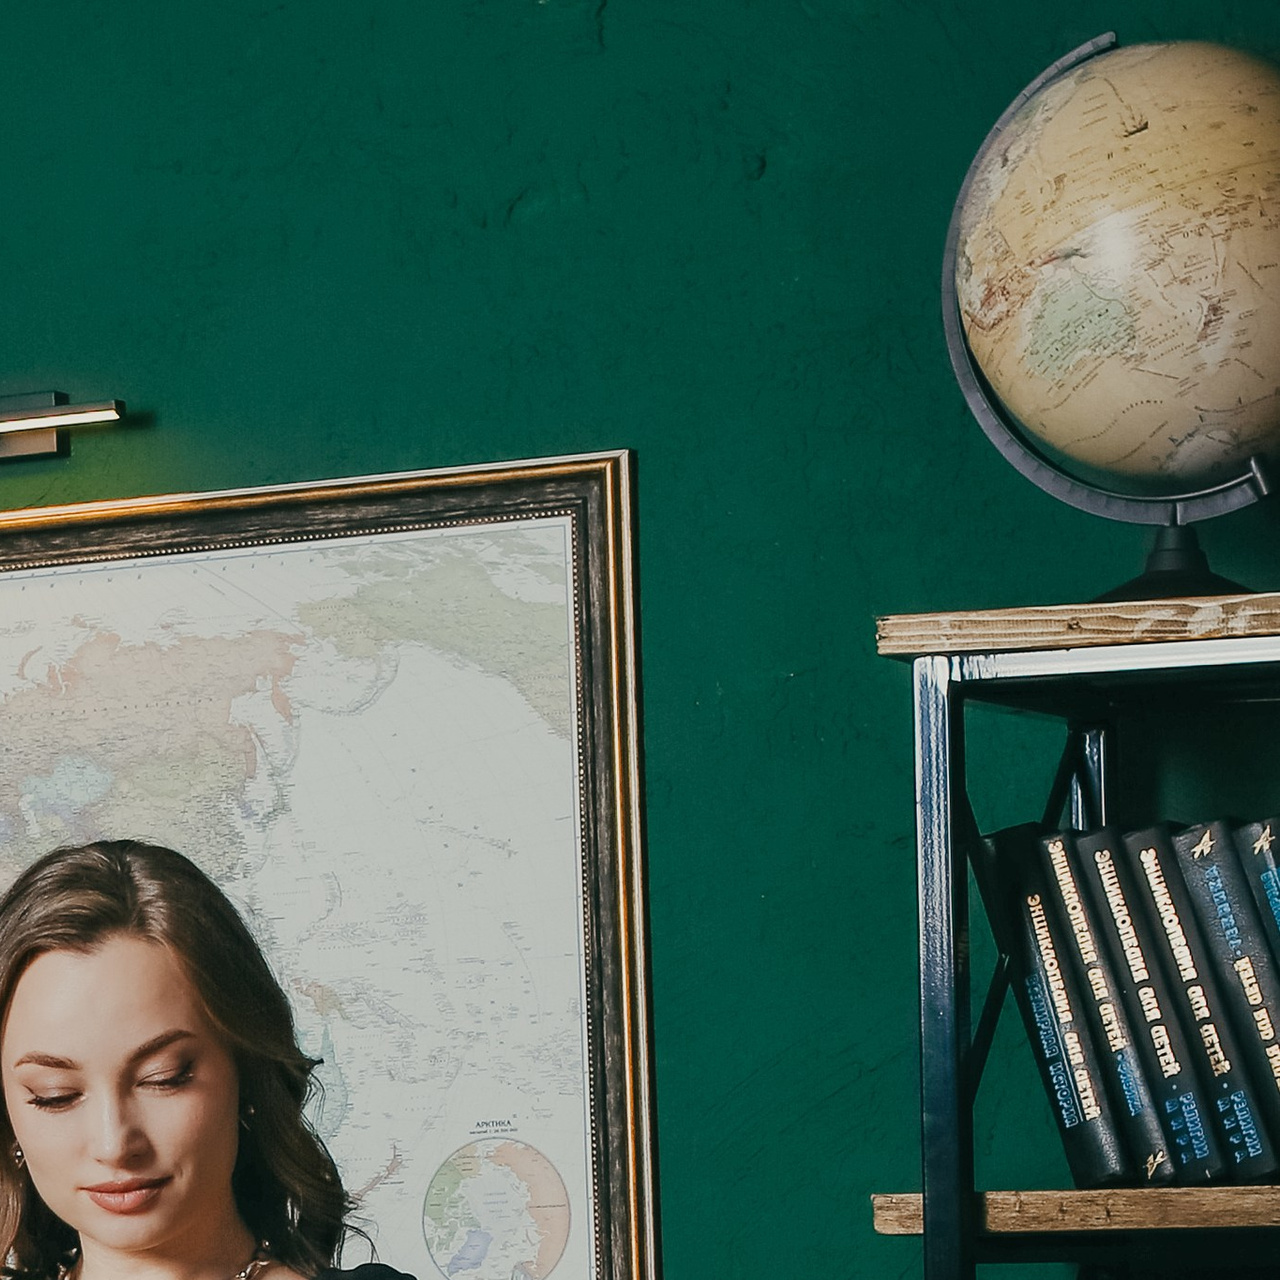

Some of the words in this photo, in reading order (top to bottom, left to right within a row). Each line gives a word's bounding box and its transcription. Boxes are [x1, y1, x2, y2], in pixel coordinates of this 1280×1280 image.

[1205, 865, 1244, 950] ТЕХНИКА
[1025, 894, 1073, 1024] ЭНЦИКЛОПЕДИЯ
[1047, 840, 1098, 966] ЭНЦИКЛОПЕДИЯ
[1087, 966, 1111, 1001] ДЛЯ
[1099, 1003, 1128, 1053] ДЕТЕЙ
[1117, 1061, 1144, 1117] ФИЗИКА
[1095, 849, 1150, 984] ЭНЦИКЛОПЕДИЯ
[1137, 985, 1162, 1023] ДЛЯ
[1150, 1023, 1182, 1079] ДЕТЕЙ
[1139, 847, 1199, 983] ЭНЦИКЛОПЕДИЯ
[1187, 984, 1211, 1022] ДЛЯ
[1199, 1023, 1232, 1078] ДЕТЕЙ
[1233, 955, 1264, 1006] ДЕТЕЙ
[1025, 974, 1060, 1058] ВСЕМИРНАЯ
[1048, 1061, 1079, 1128] ИСТОРИЯ
[1064, 1031, 1085, 1065] ДЛЯ
[1252, 1006, 1276, 1042] ДЛЯ
[475, 1119, 512, 1128] АРКТИКА
[1073, 1068, 1102, 1122] ДЕТЕЙ
[1179, 1091, 1210, 1159] РЕЛИГИИ
[1231, 1090, 1263, 1157] РЕЛИГИИ
[1165, 1098, 1194, 1164] МИРА
[1217, 1097, 1247, 1163] МИРА
